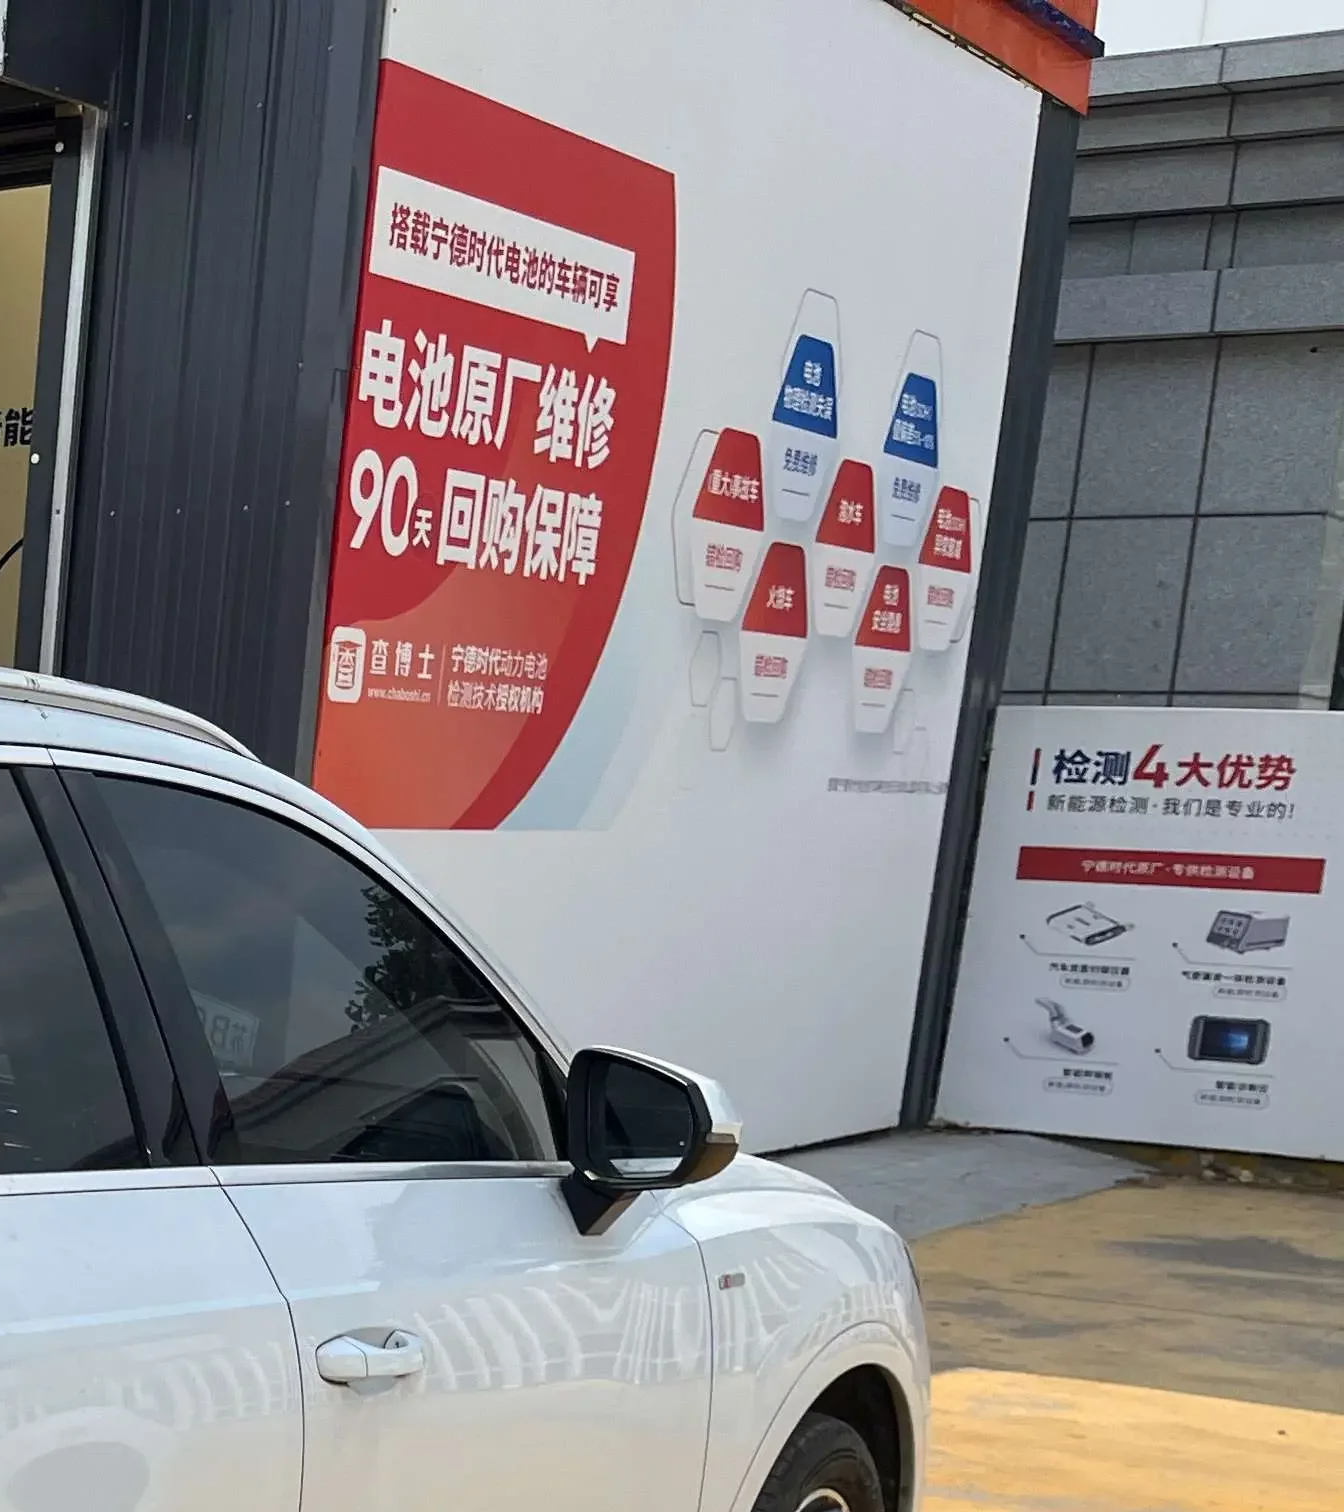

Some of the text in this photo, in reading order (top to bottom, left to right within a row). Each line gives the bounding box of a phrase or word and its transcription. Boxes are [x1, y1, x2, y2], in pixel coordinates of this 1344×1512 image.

[388, 202, 621, 313] 搭载宁德时代电池的车辆可享
[357, 318, 618, 470] 电池原厂维修
[369, 638, 436, 681] 查博士
[1052, 743, 1297, 791] 检测4大优势
